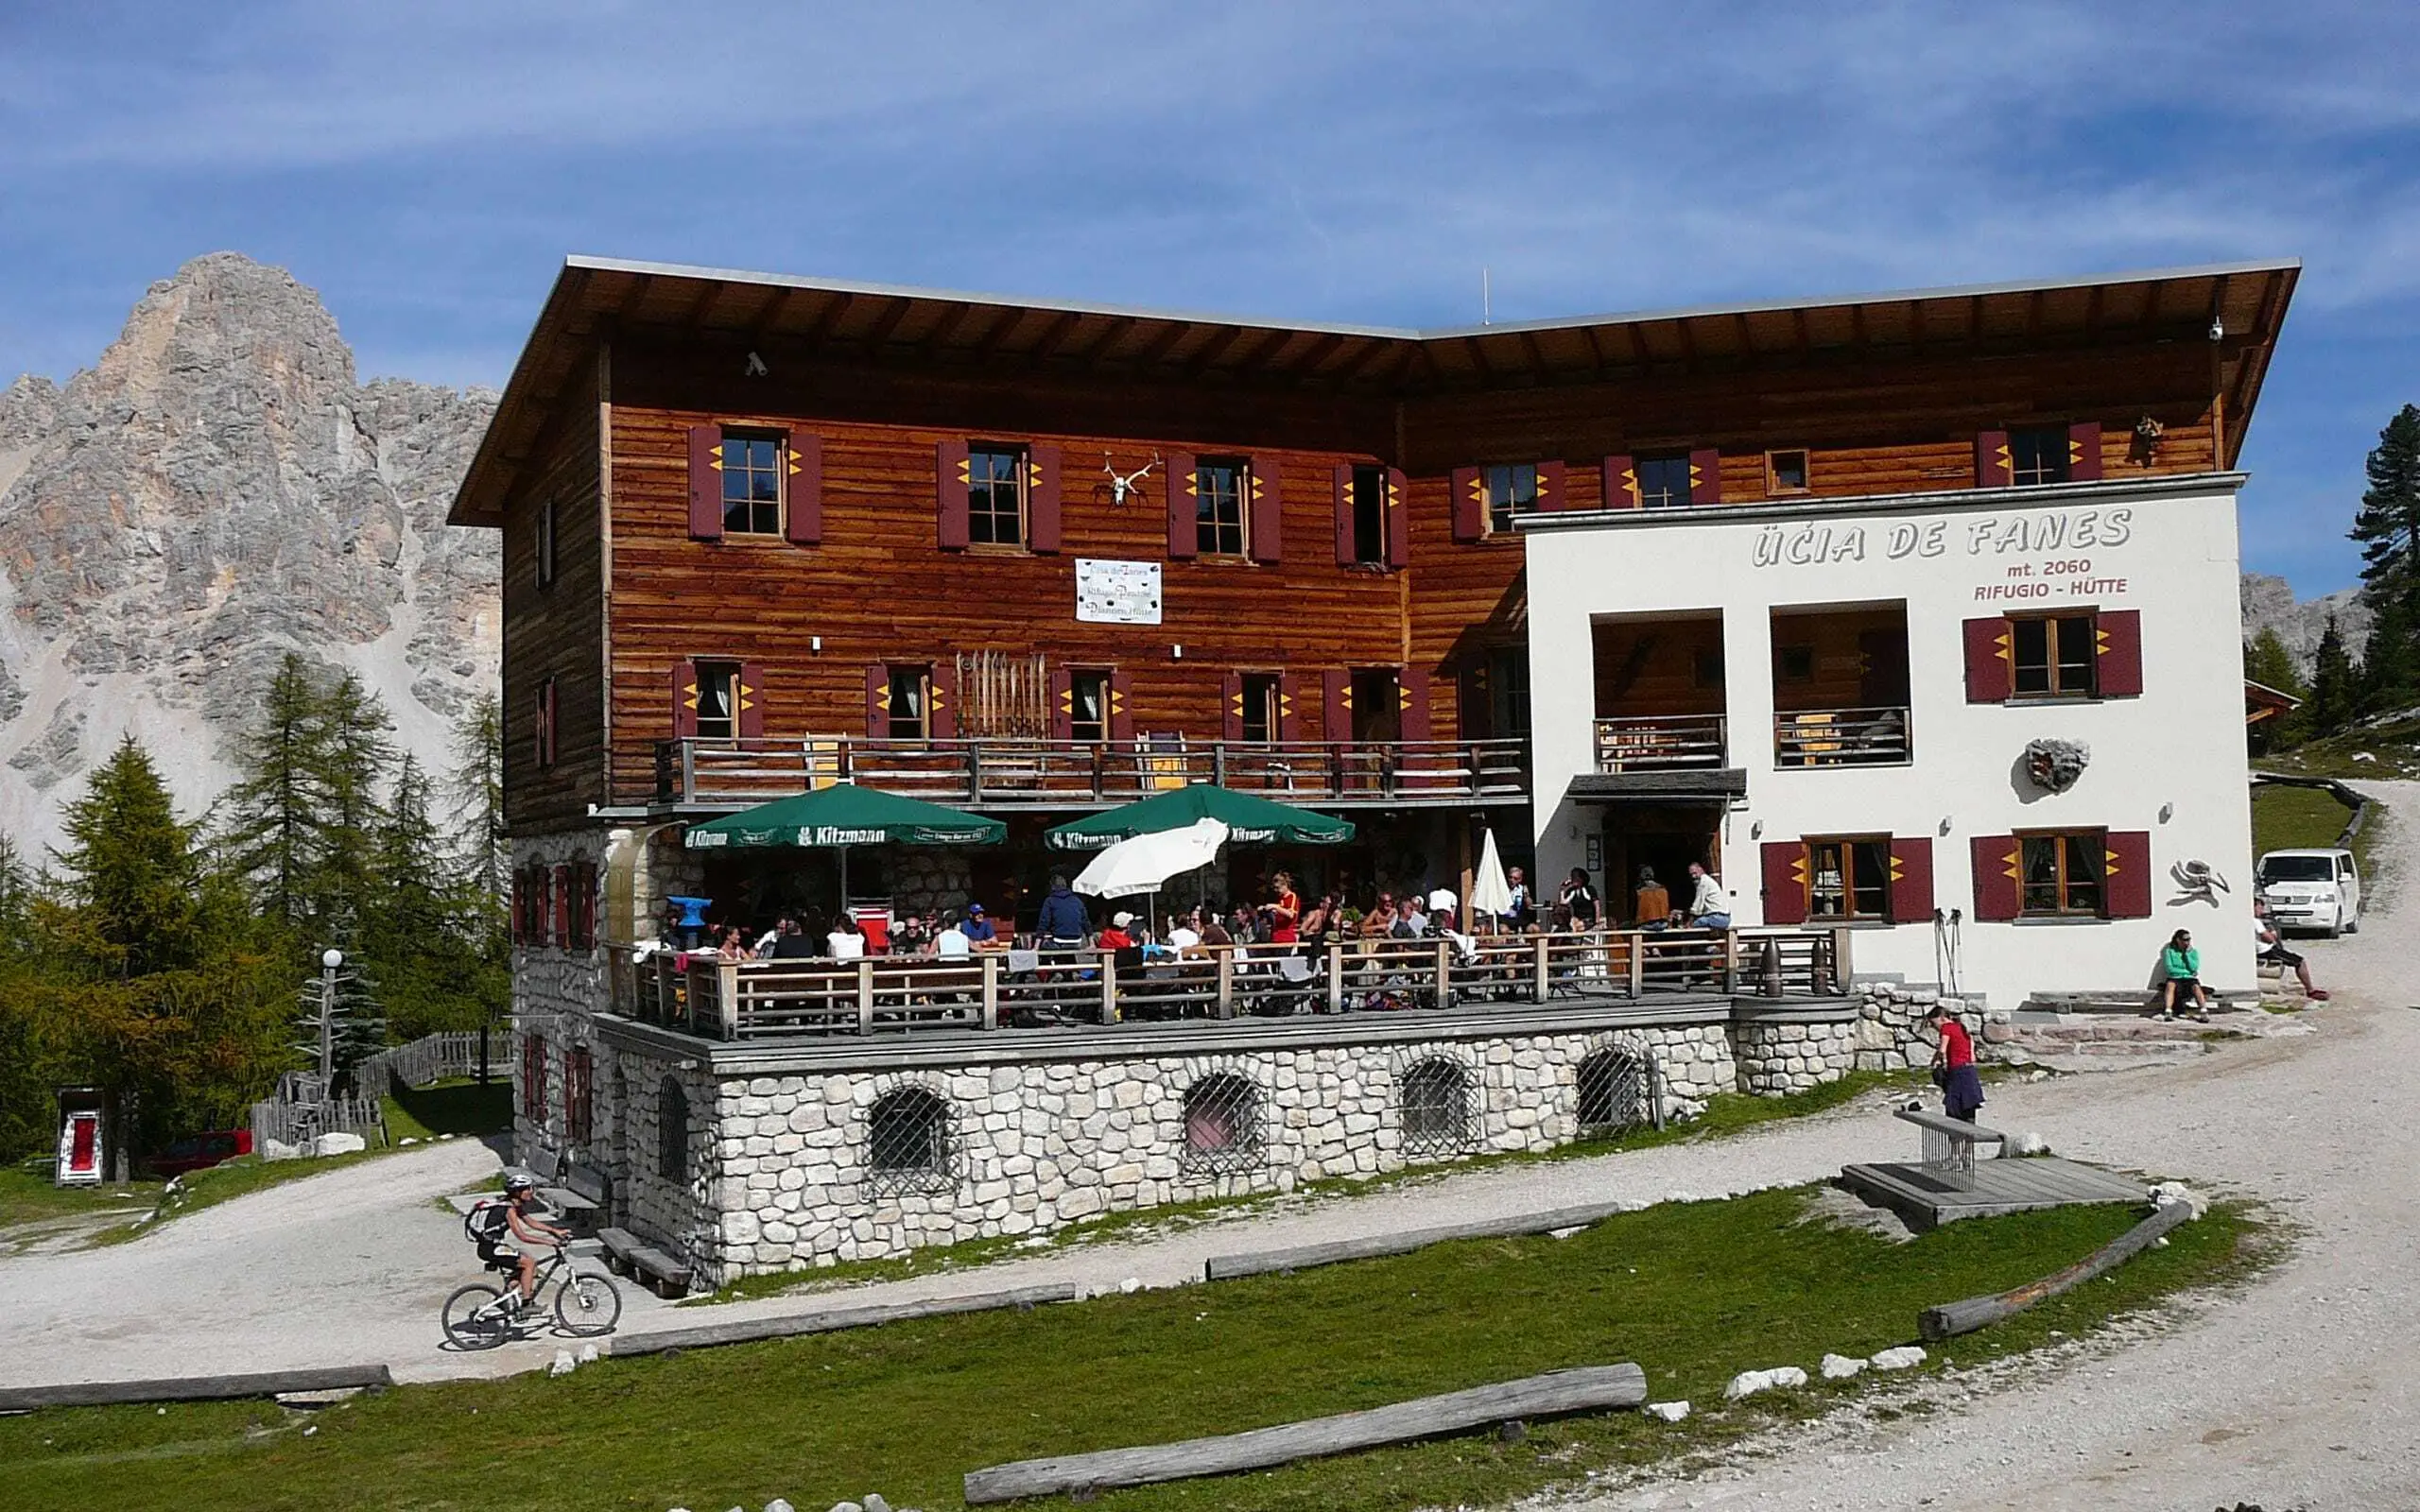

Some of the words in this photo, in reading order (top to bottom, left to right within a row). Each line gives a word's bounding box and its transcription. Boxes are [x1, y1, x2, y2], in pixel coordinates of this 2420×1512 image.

[1887, 520, 1947, 559] DE
[1967, 508, 2132, 555] FANES
[2007, 563, 2035, 577] mt.
[2043, 558, 2091, 576] 2060
[1974, 582, 2049, 600] RIFUGIO
[2070, 576, 2127, 595] HÜTTE
[816, 826, 886, 845] Kitzmann
